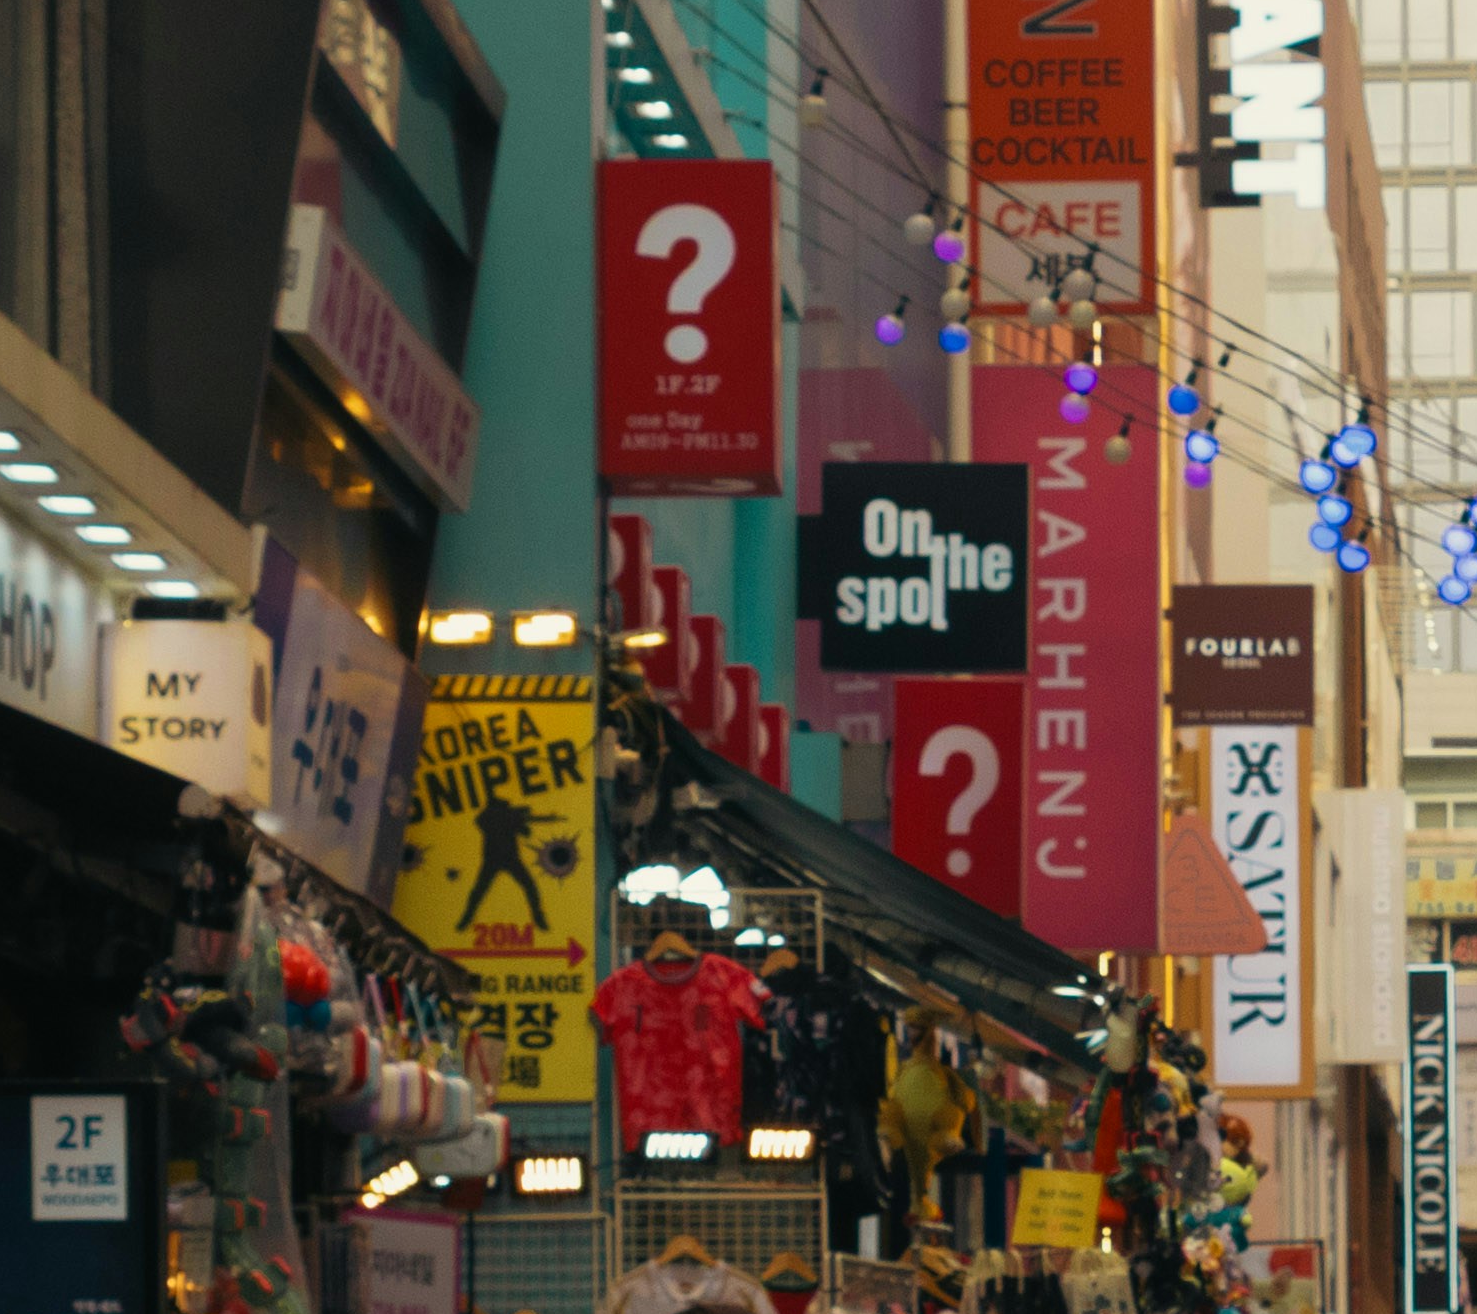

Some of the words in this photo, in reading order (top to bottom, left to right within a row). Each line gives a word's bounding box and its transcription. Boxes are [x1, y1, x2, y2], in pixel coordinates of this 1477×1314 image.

[984, 58, 1123, 87] COFFEE
[1008, 97, 1099, 127] BEER
[973, 137, 1147, 167] COCKTAIL
[994, 201, 1121, 238] CAFE
[864, 498, 932, 558] On
[930, 532, 1012, 591] the
[837, 576, 949, 631] spot
[1185, 636, 1301, 658] FOURLAB
[146, 671, 202, 698] MY
[121, 716, 228, 744] STORY
[1227, 811, 1287, 1035] SATUR
[505, 974, 585, 994] RANGE
[461, 1003, 560, 1049] 격장
[1415, 1013, 1446, 1118] NICK
[56, 1115, 103, 1150] 2F
[41, 1164, 116, 1186] 우대포
[1415, 1125, 1447, 1273] NICOLE
